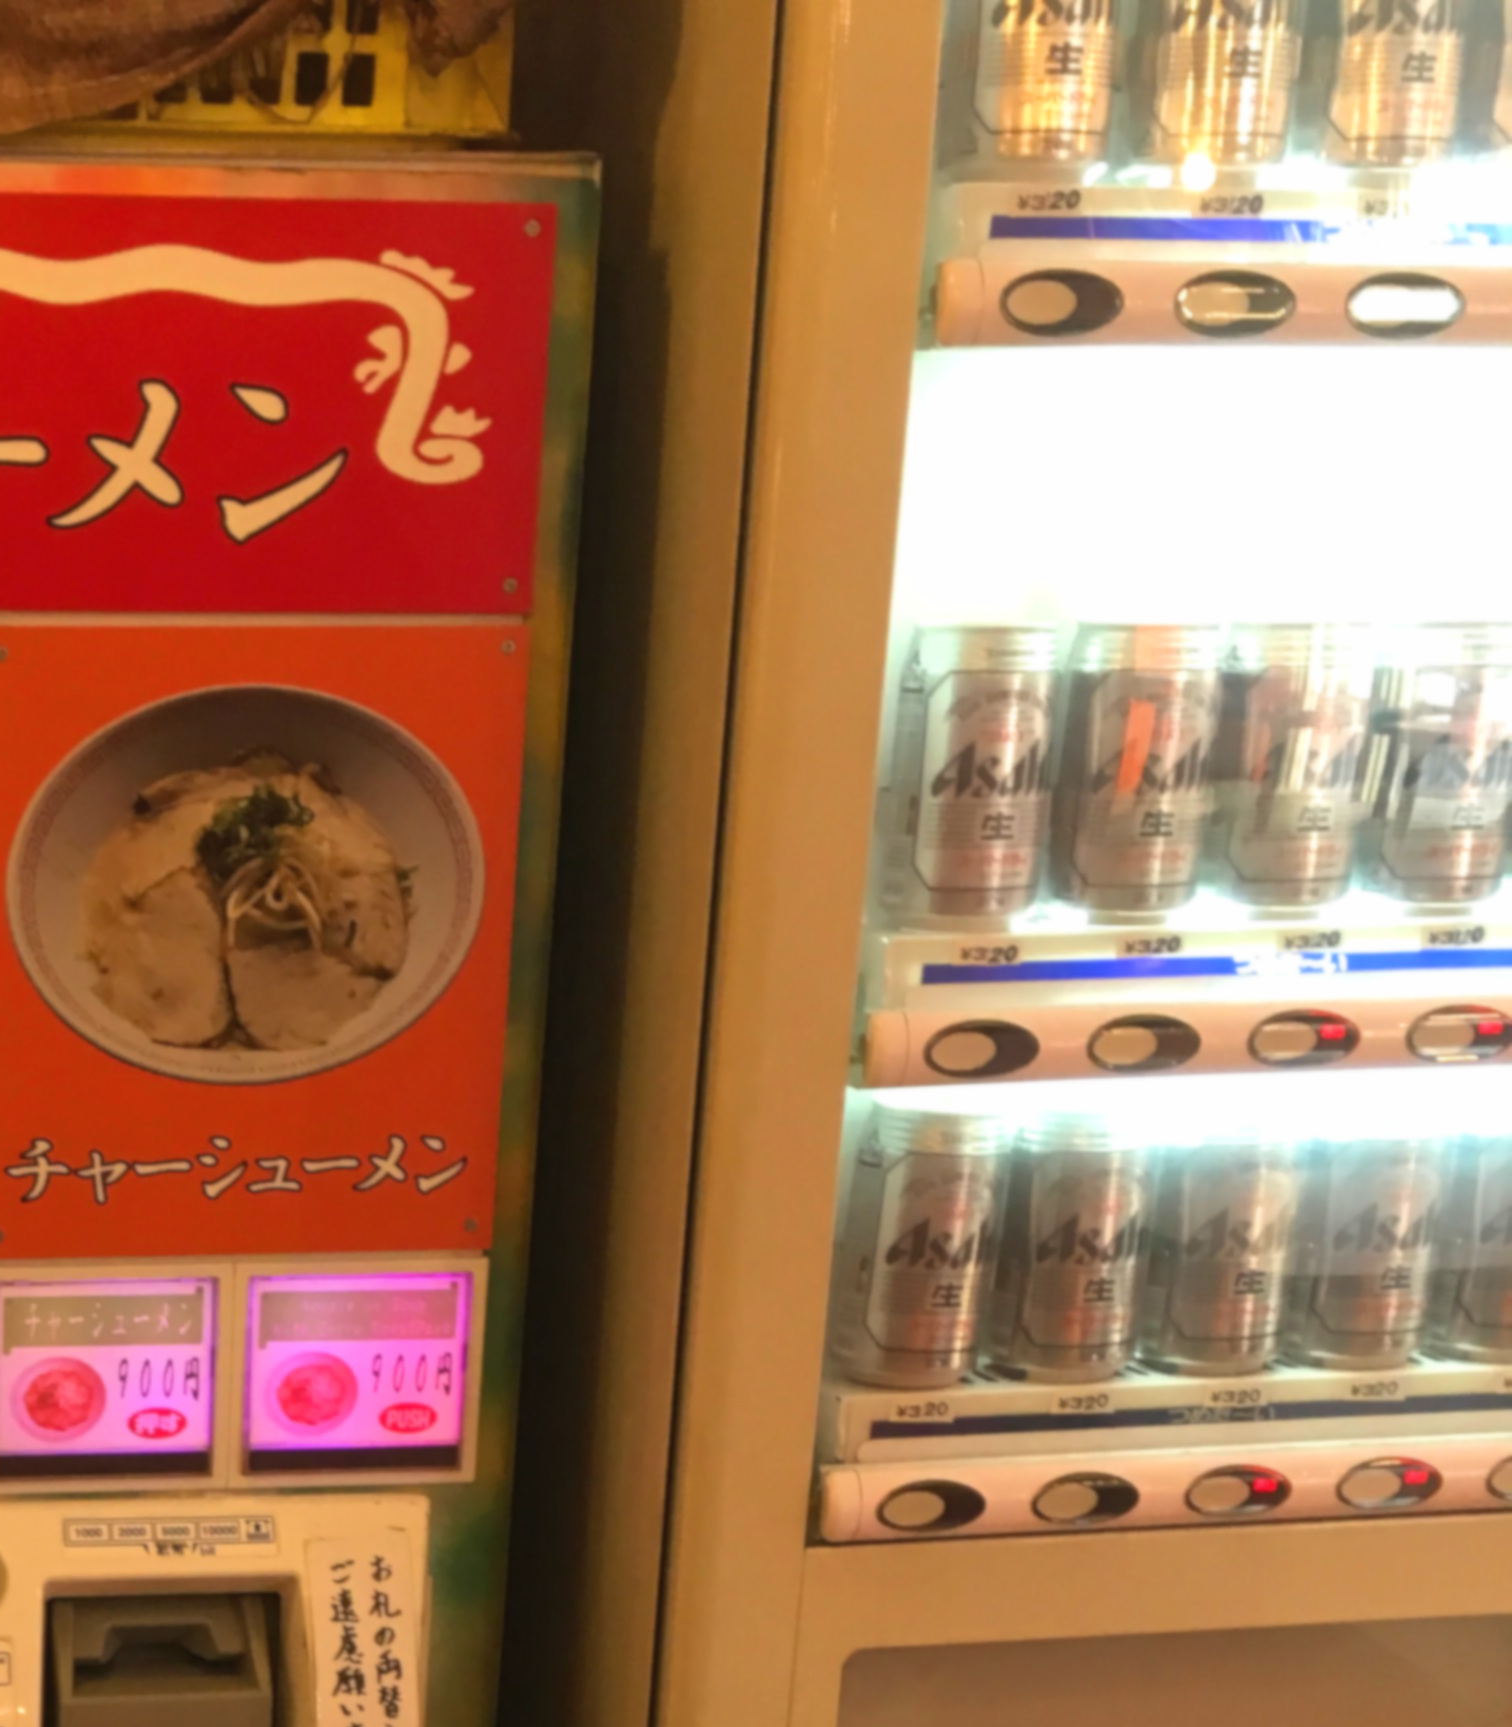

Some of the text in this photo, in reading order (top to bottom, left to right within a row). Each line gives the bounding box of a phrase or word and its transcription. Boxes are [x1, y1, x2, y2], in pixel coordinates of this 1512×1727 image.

[1045, 41, 1083, 75] 生
[1401, 52, 1437, 84] 生
[981, 812, 1015, 840] 生
[1139, 811, 1174, 838] 生
[1125, 935, 1182, 954] ¥320
[5, 1135, 468, 1205] チャーシューメン
[1083, 1277, 1116, 1302] 生
[1234, 1270, 1266, 1295] 生
[1381, 1265, 1412, 1290] 生
[931, 1283, 963, 1308] 生
[387, 1408, 430, 1429] PUSH
